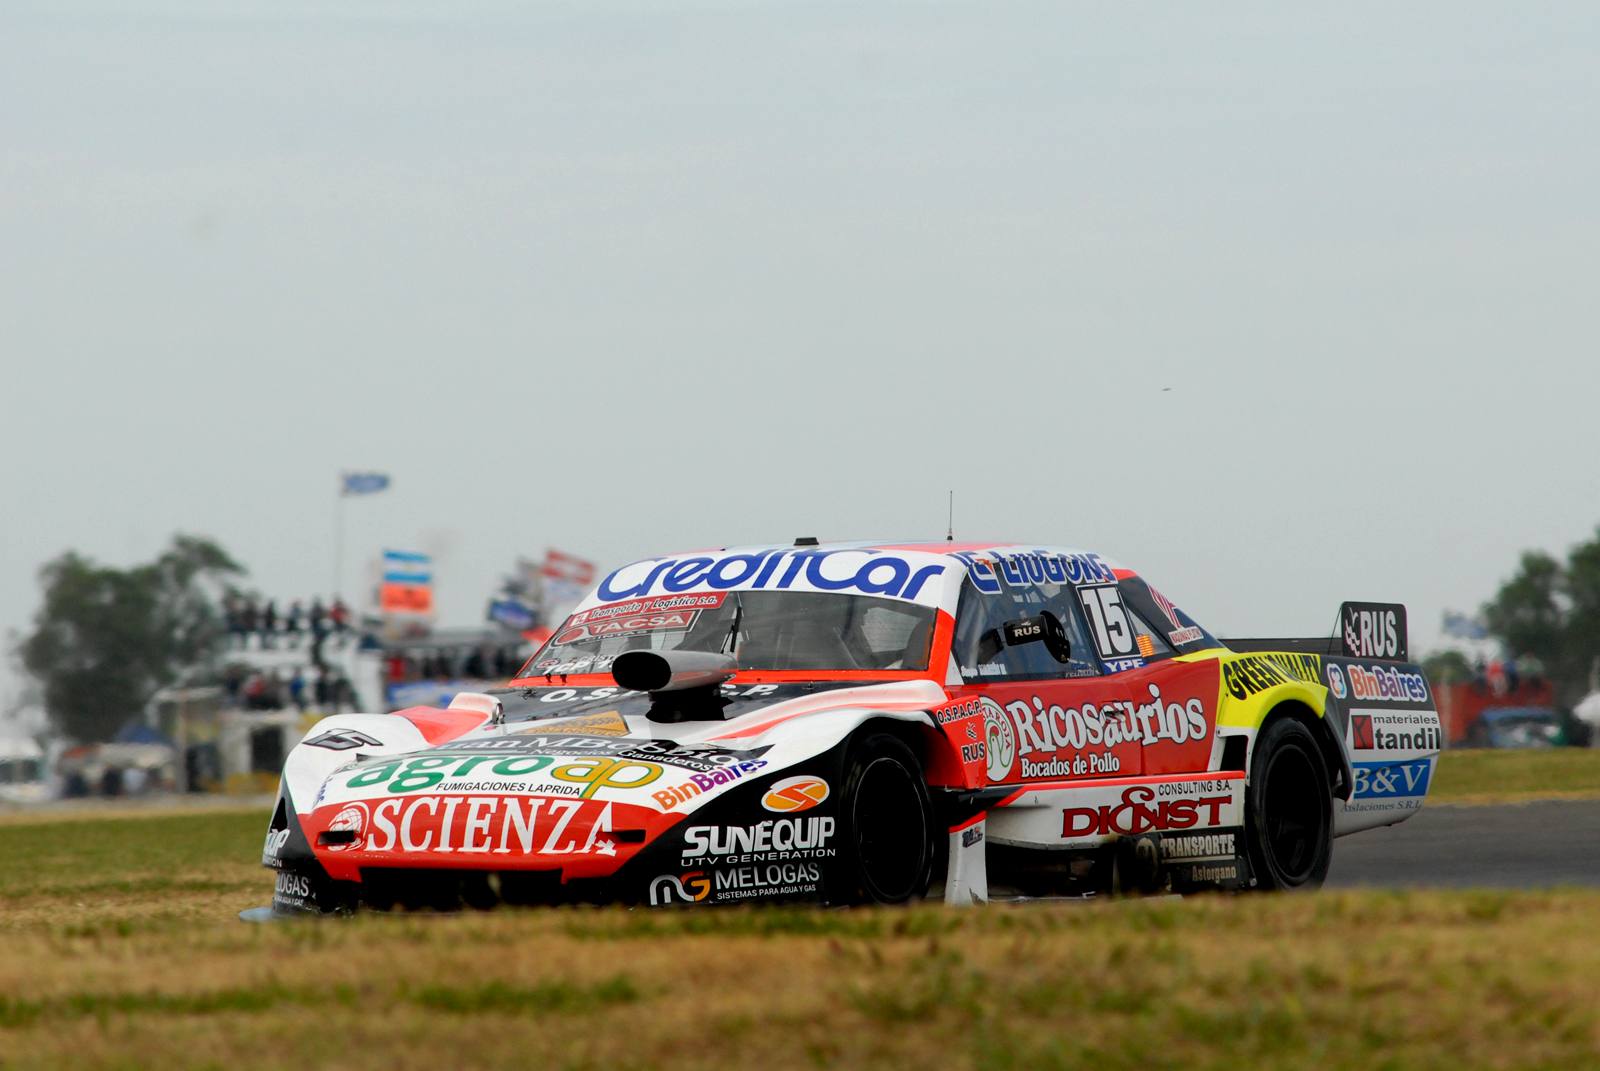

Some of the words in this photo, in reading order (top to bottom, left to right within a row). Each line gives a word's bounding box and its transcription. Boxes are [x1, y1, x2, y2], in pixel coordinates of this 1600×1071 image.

[591, 602, 641, 619] Transporte
[643, 601, 651, 611] y
[1081, 587, 1133, 655] 15
[594, 614, 685, 634] TACSA
[1013, 624, 1041, 638] RUS
[1360, 611, 1398, 657] RUS
[1104, 657, 1146, 673] YPF
[1223, 655, 1288, 701] GREEN
[1349, 665, 1427, 701] BinBaires
[936, 700, 983, 725] O.S.P.A.C.P.
[1006, 684, 1207, 756] Ricosaurios
[1373, 714, 1438, 725] materiales
[1375, 727, 1441, 750] tandil
[617, 750, 713, 771] Ganaderos
[962, 742, 985, 764] RUS
[1021, 758, 1070, 778] Bocados
[1073, 755, 1087, 775] de
[1089, 752, 1120, 773] Pollo
[436, 782, 526, 793] FUMIGACIONES
[528, 783, 580, 796] LAPRIDA
[652, 758, 768, 811] BinBaires
[1159, 780, 1213, 796] CONSULTING
[1216, 779, 1233, 791] S.A.
[1353, 764, 1427, 794] B&V
[364, 797, 617, 857] SCIENZA
[682, 816, 836, 858] SUNEQUIP
[681, 856, 719, 867] UTV
[726, 848, 836, 864] GENERATION
[1161, 833, 1236, 858] TRANSPORTE
[715, 862, 820, 890] MELOGAS
[1192, 865, 1237, 881] Astorgano
[717, 889, 757, 901] SISTEMAS
[759, 887, 779, 897] PARA
[780, 886, 798, 895] AGUA
[804, 884, 816, 893] GAS
